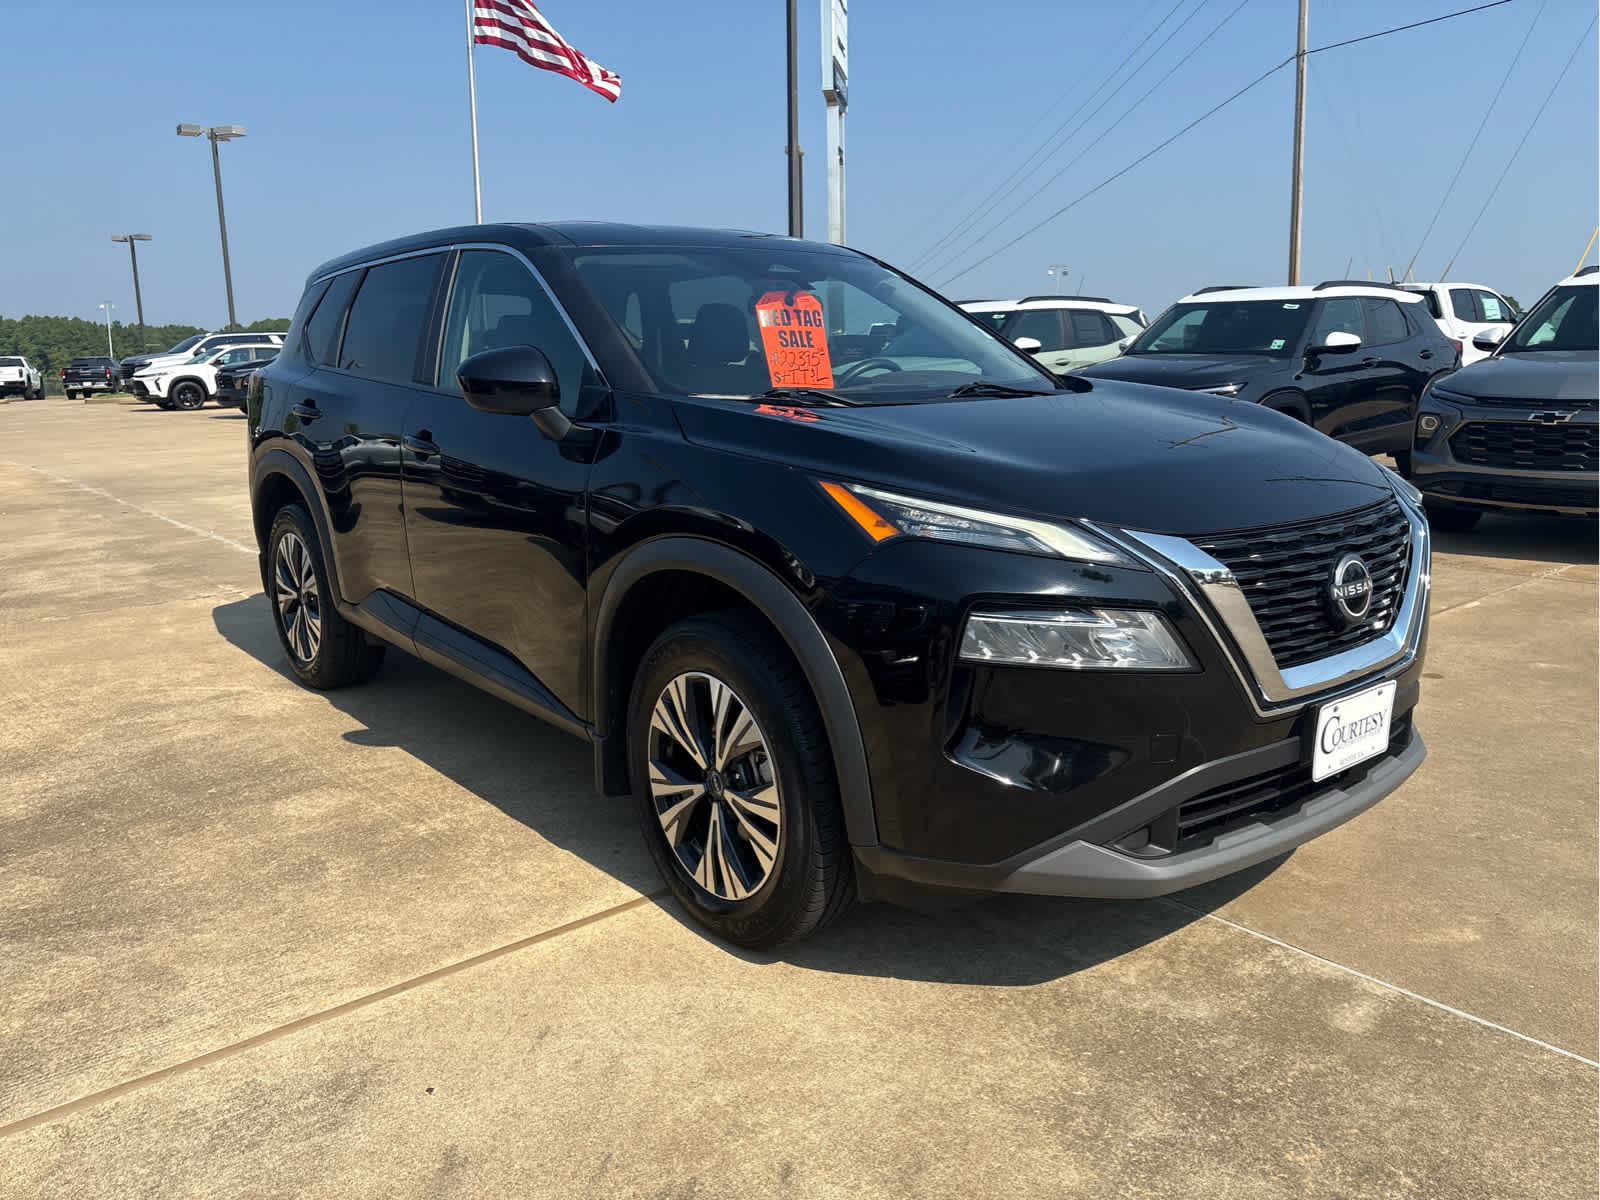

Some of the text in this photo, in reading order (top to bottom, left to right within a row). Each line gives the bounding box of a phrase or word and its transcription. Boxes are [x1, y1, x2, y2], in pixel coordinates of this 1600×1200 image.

[759, 309, 824, 328] RED TAG
[778, 330, 815, 348] SALE
[1333, 580, 1373, 598] NISSAN
[1321, 709, 1387, 755] COURTESY
